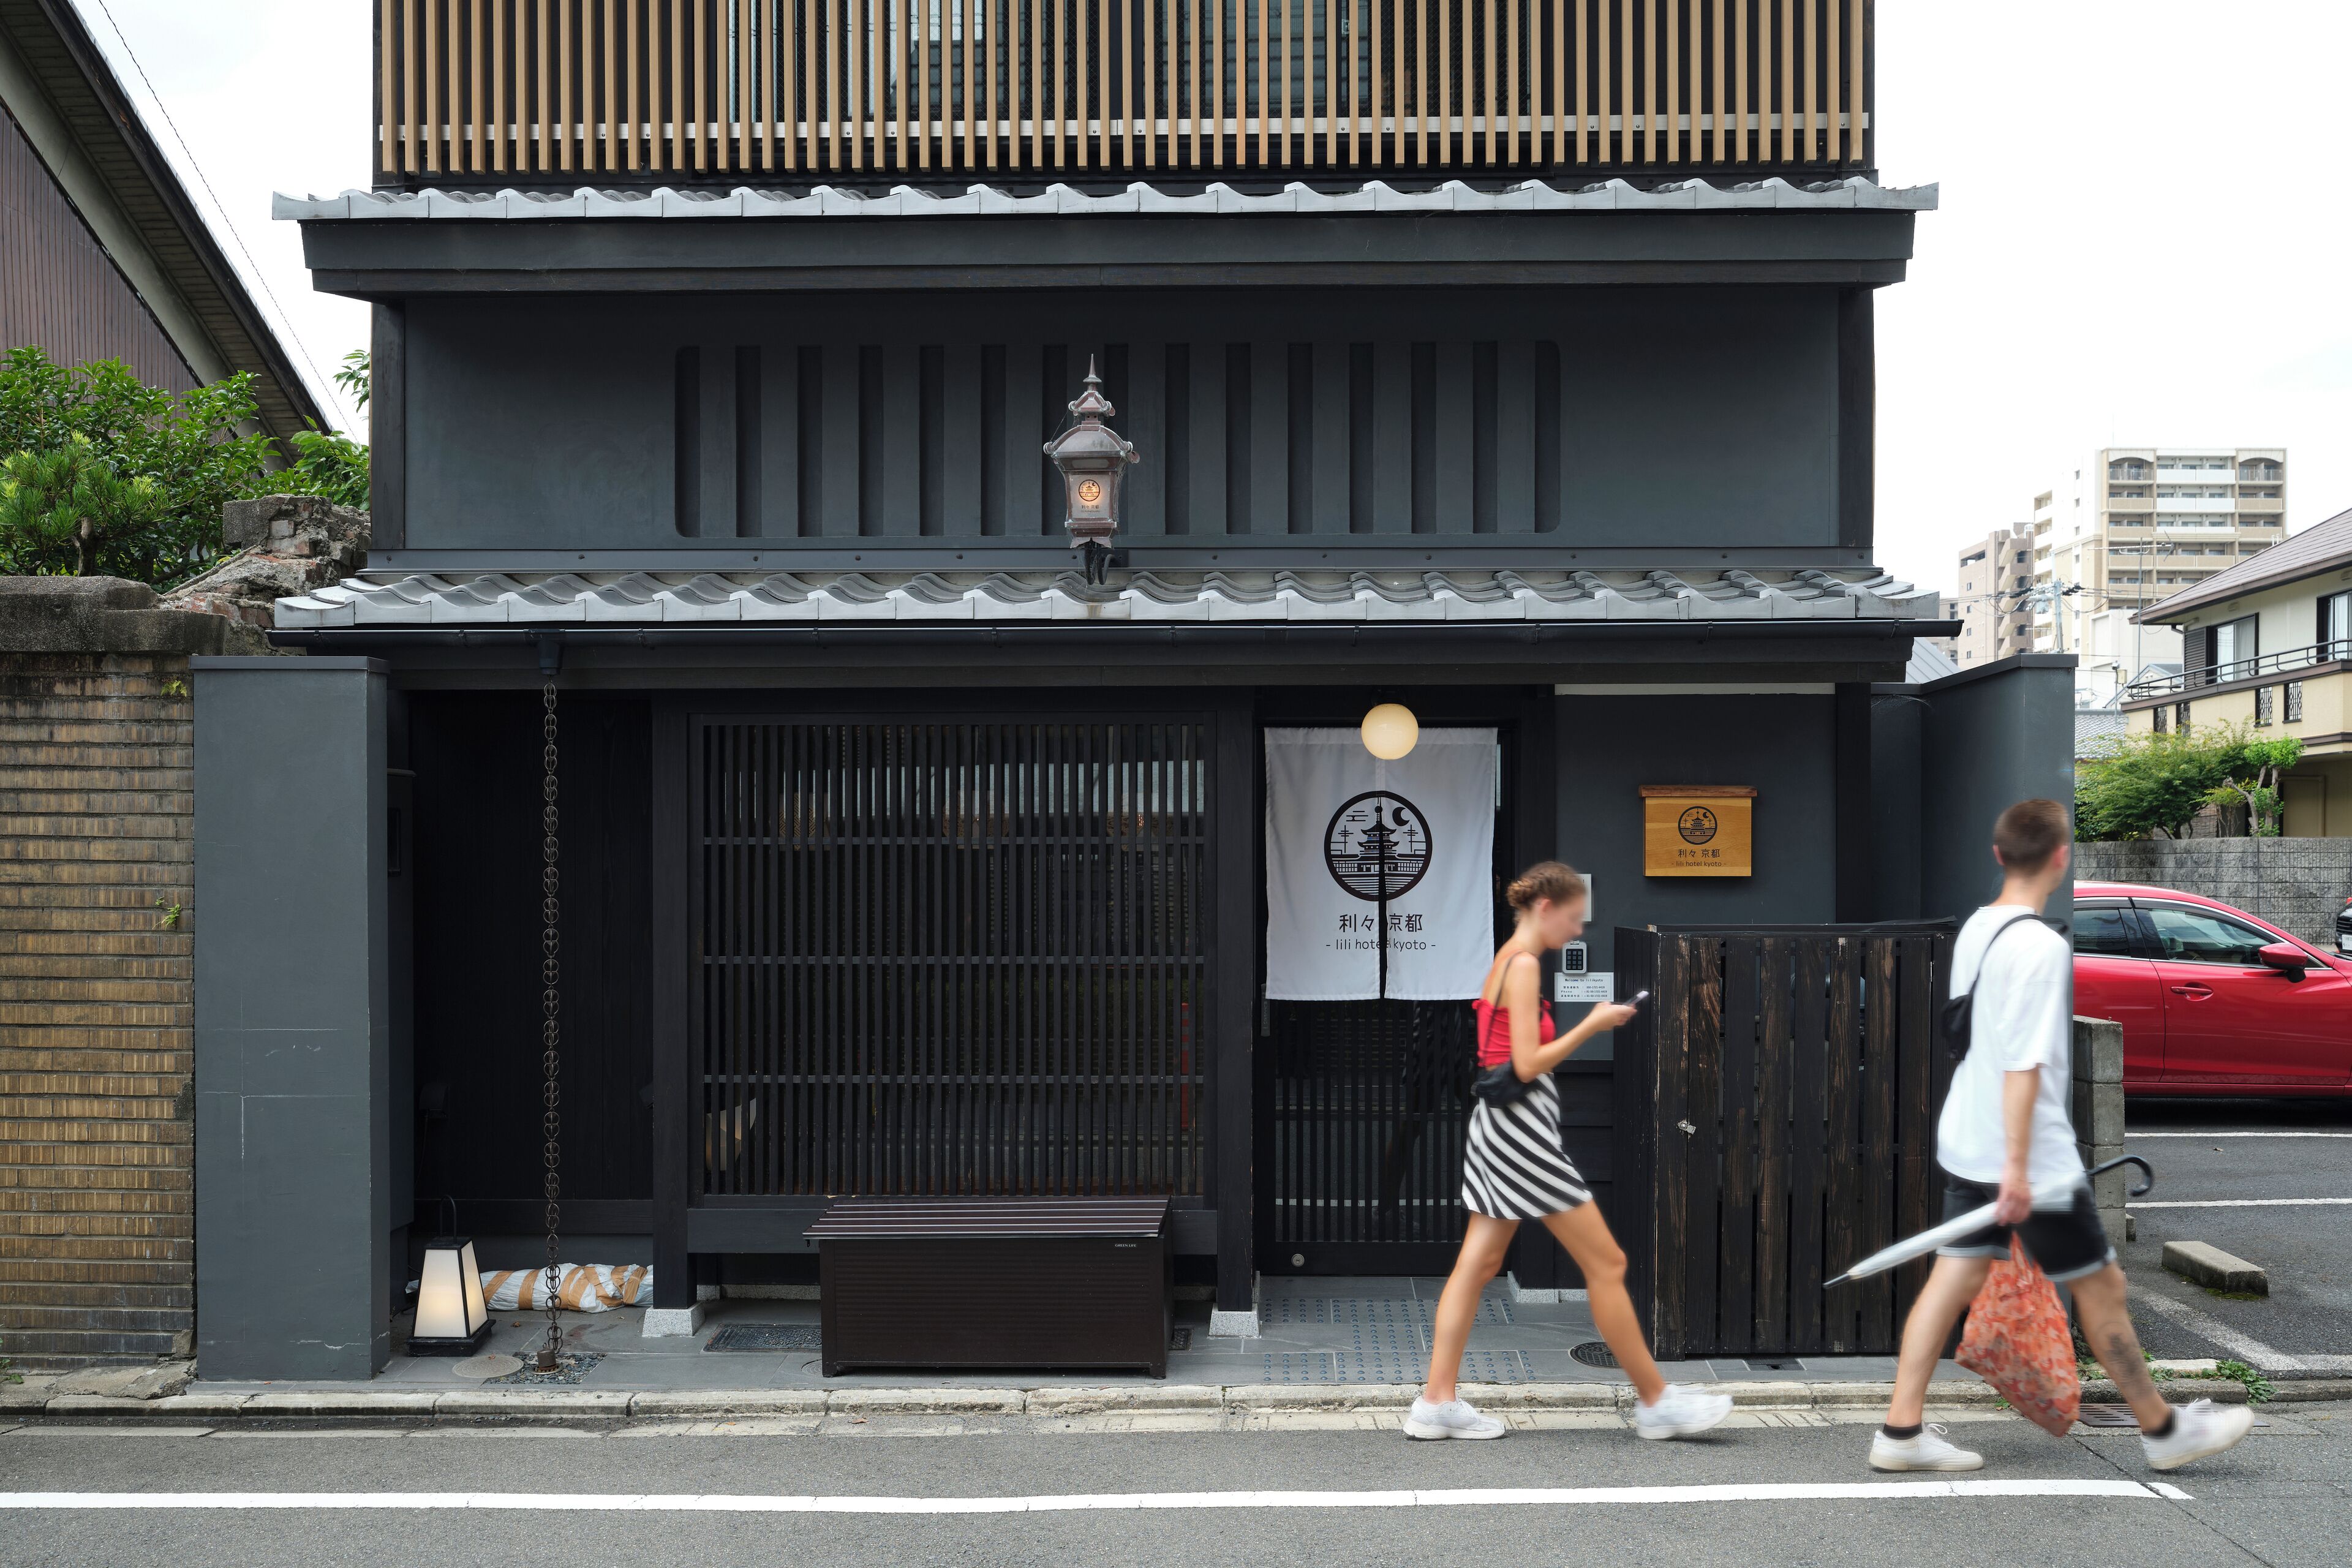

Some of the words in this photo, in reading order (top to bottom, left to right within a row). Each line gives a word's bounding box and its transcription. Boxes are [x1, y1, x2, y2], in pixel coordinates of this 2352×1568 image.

[1678, 849, 1696, 858] 利々
[1701, 849, 1720, 858] 京都
[1339, 914, 1374, 932] 利々
[1389, 913, 1423, 932] 京都
[1336, 939, 1351, 949] lili
[1393, 938, 1427, 952] kyoto
